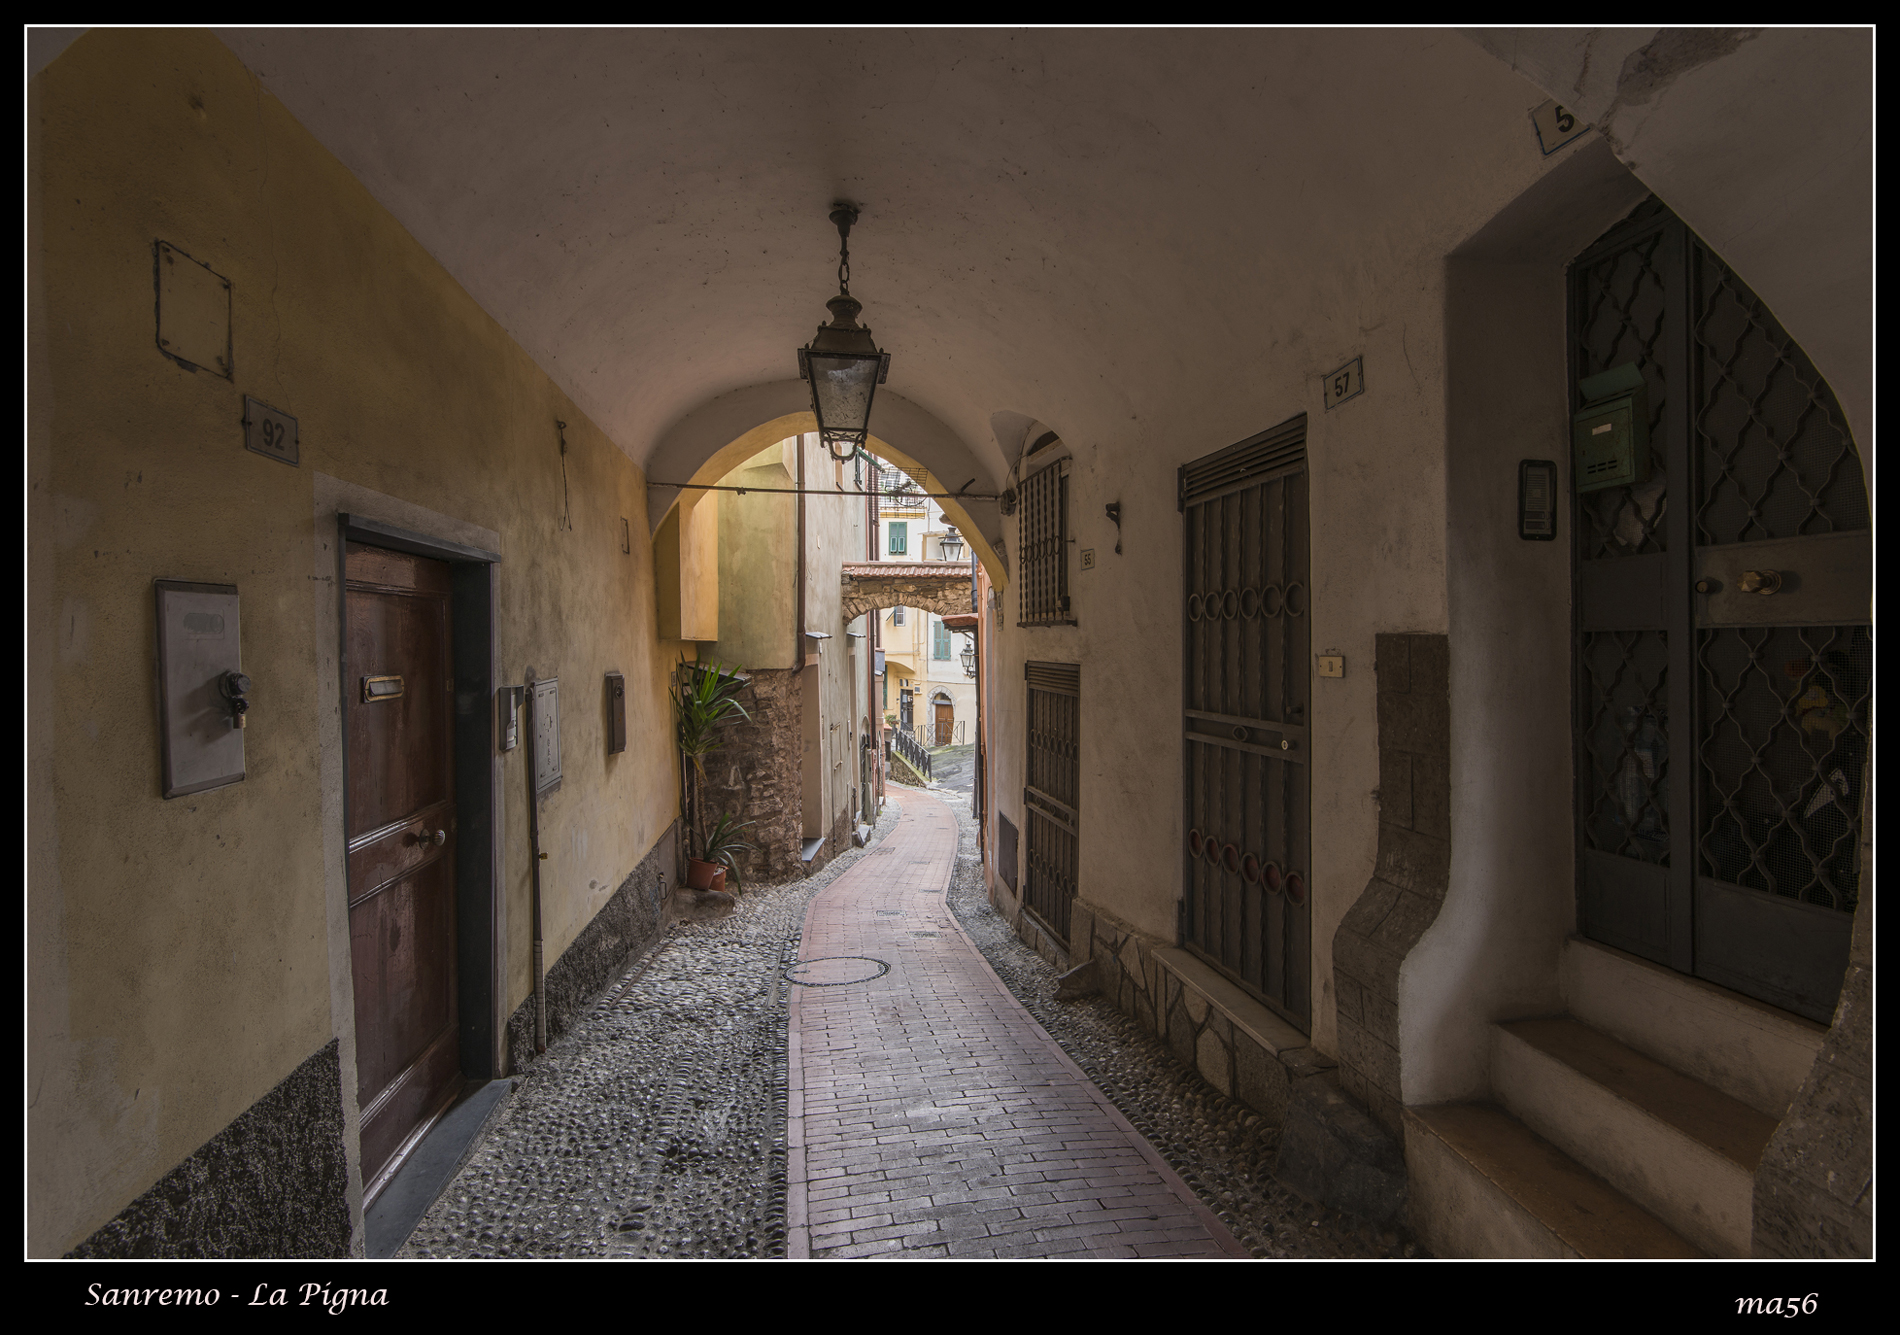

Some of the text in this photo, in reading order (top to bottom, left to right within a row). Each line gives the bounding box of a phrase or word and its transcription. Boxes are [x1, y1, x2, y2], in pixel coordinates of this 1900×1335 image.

[1334, 371, 1350, 397] 57
[262, 418, 285, 451] 92
[1084, 553, 1092, 566] 55
